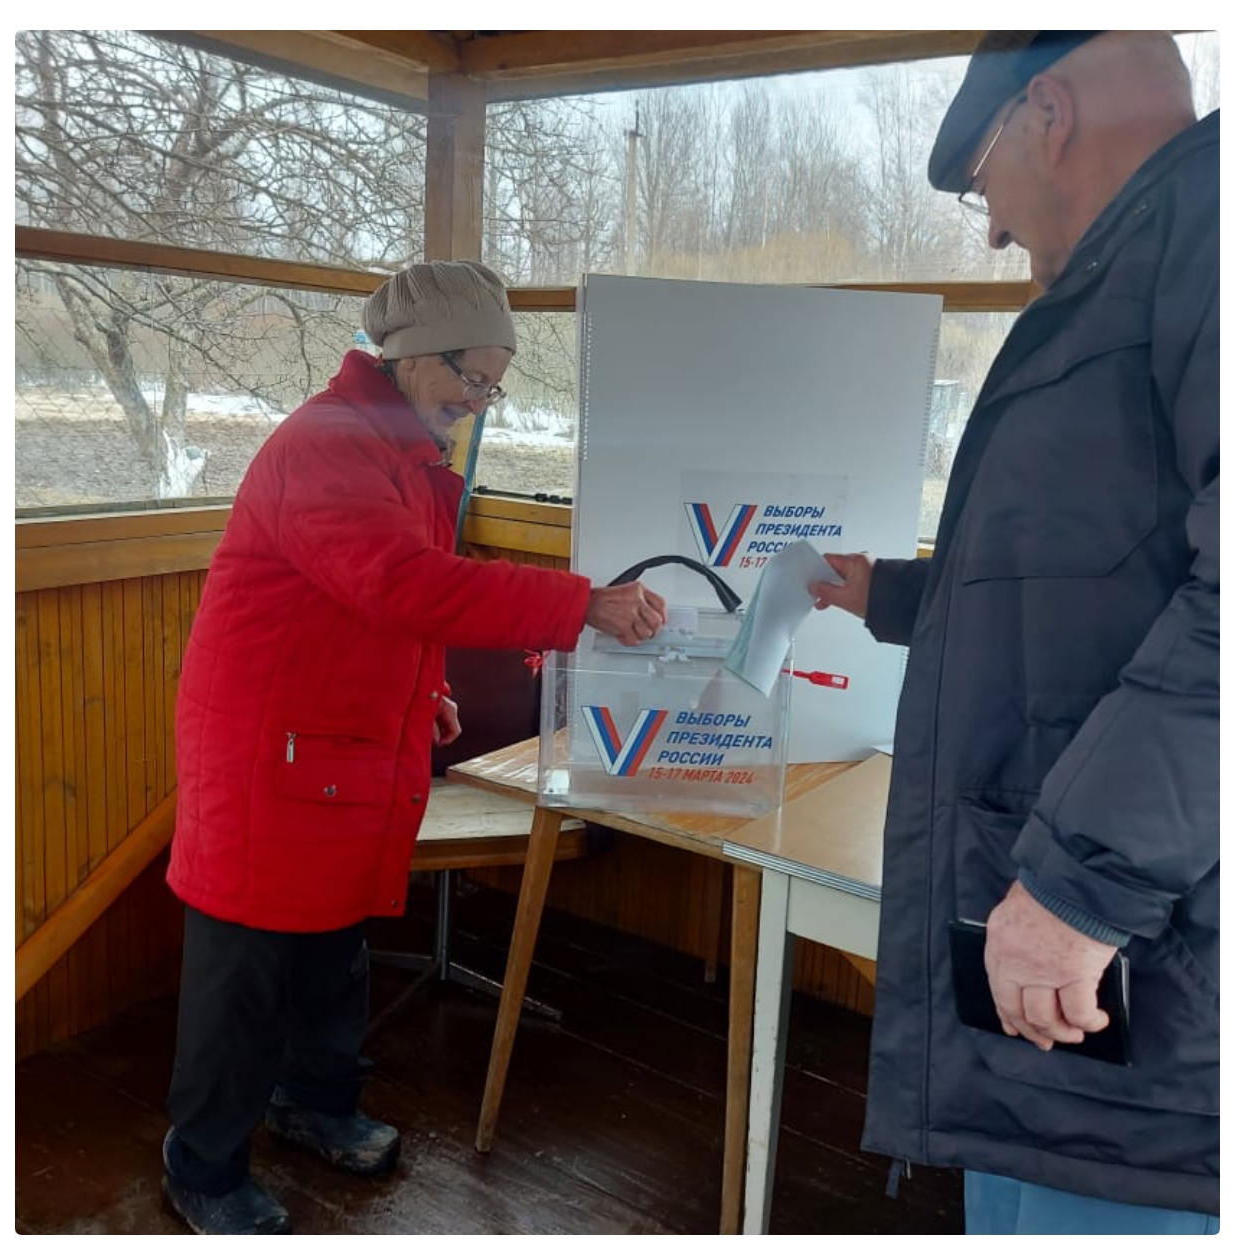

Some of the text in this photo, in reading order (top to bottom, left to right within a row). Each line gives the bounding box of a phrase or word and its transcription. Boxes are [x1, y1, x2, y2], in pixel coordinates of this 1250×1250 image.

[763, 505, 825, 518] ВЫБОРЫ
[754, 523, 842, 538] ПРЕЗИДЕНТА
[747, 541, 794, 553] РОСС
[739, 556, 767, 568] 15-17
[676, 711, 751, 727] ВЫБОРЫ
[666, 731, 774, 750] ПРЕЗИДЕНТА
[657, 750, 725, 766] РОССИИ
[649, 766, 754, 785] 15-17 МАРТА 2024
